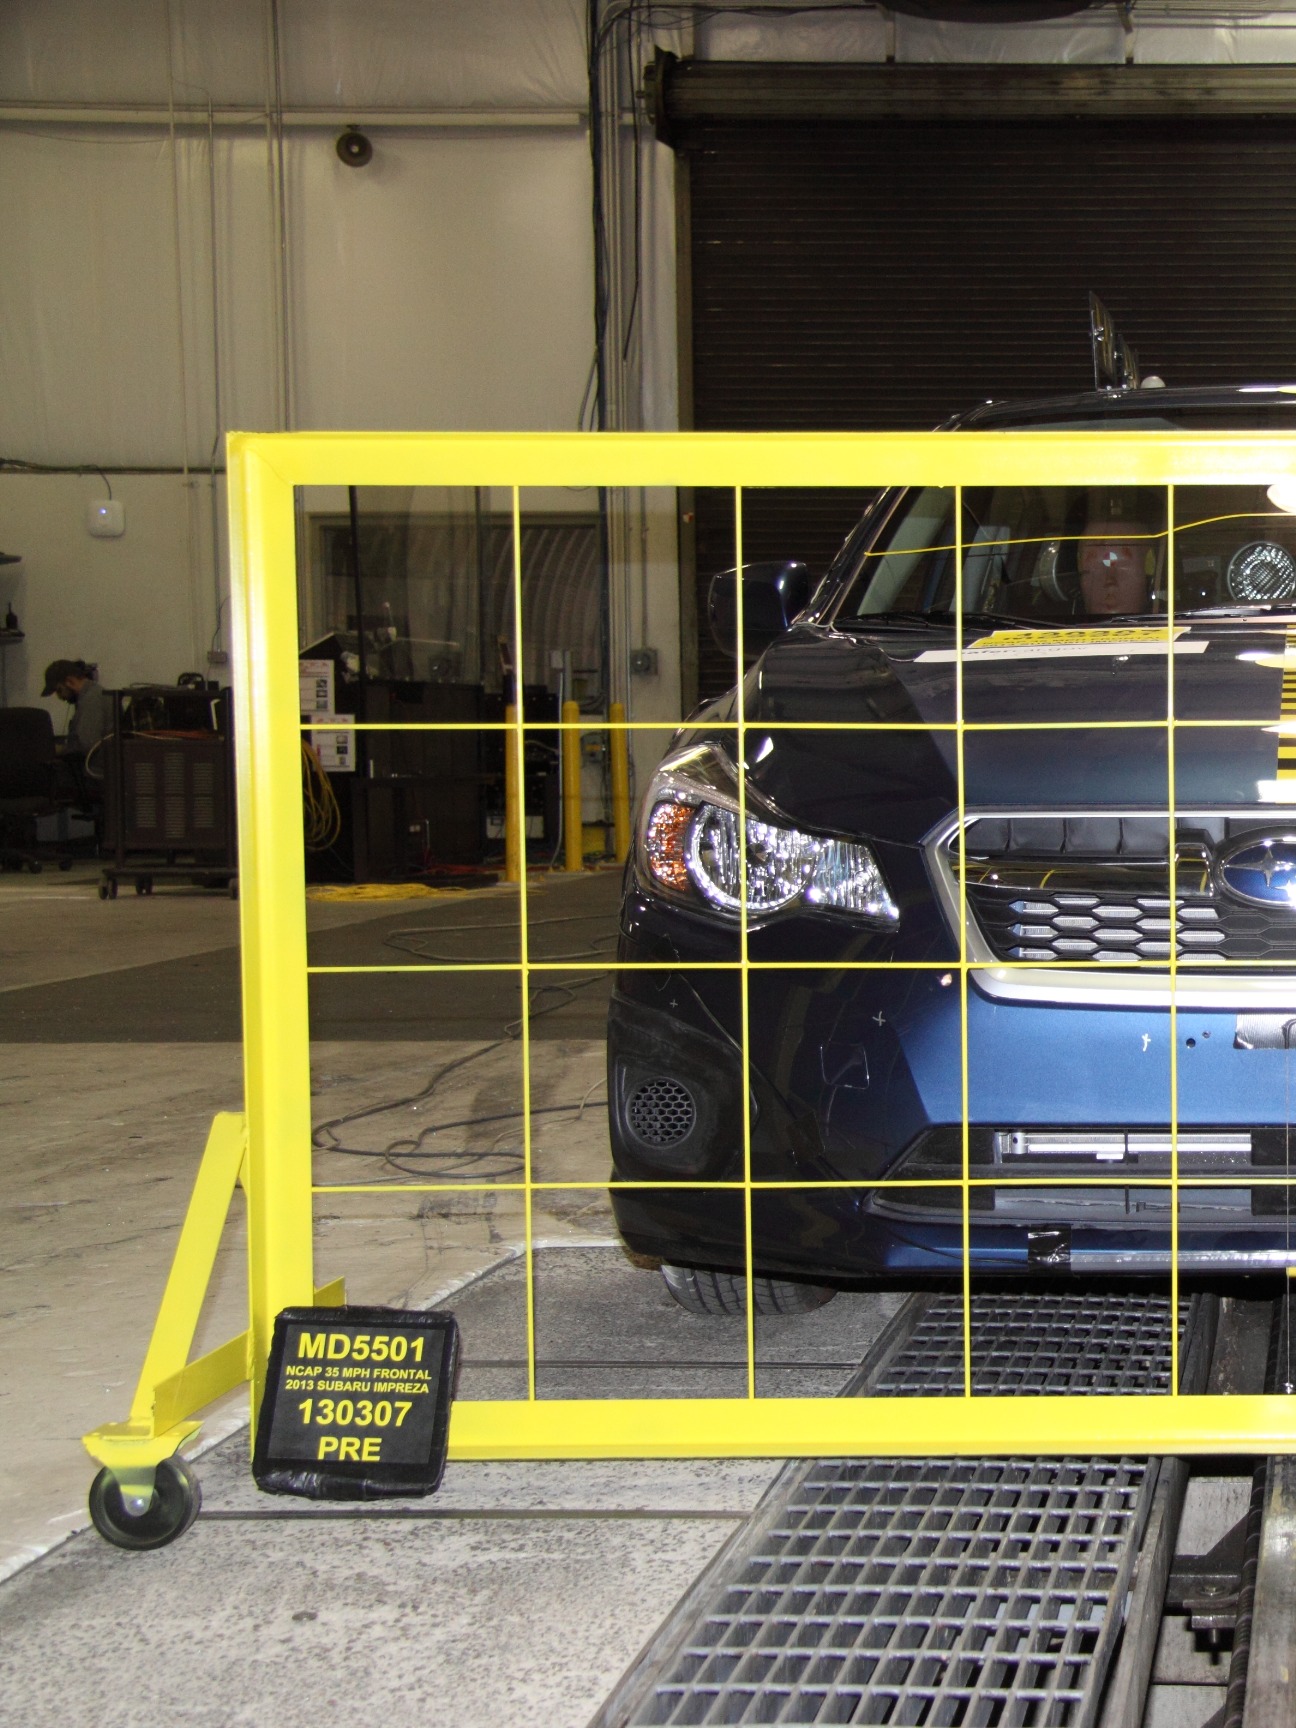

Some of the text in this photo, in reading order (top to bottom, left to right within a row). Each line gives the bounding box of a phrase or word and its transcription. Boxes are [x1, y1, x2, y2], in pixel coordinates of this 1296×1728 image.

[297, 1332, 425, 1362] MD5501
[286, 1365, 432, 1380] NCAP 35 MPH FRONTAL
[285, 1379, 430, 1394] 2013 SUBARU IMPREZA
[299, 1398, 413, 1427] 130307
[317, 1436, 383, 1462] PRE
